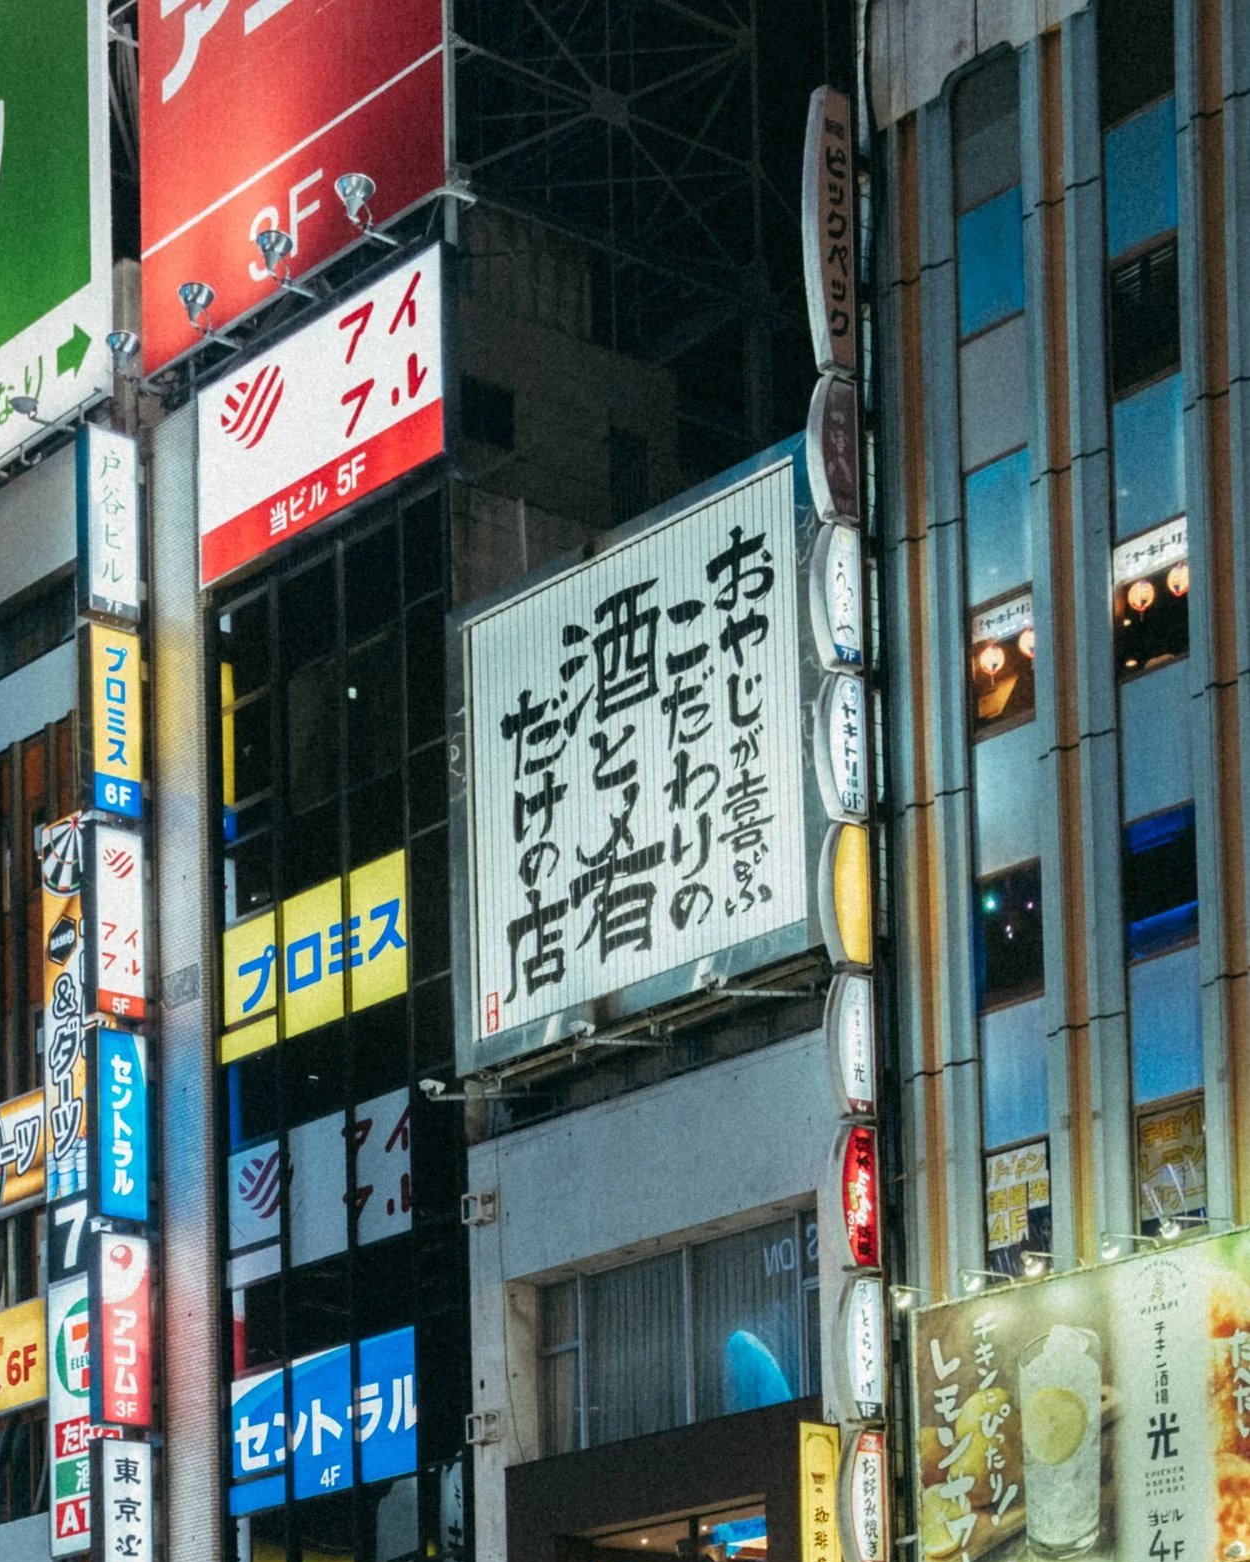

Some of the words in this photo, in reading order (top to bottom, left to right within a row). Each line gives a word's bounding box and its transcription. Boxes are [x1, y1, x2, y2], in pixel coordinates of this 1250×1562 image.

[100, 449, 128, 586] 戸谷ビル
[269, 485, 328, 537] 当ビル
[336, 451, 367, 497] 5F
[105, 646, 129, 767] プロミス
[104, 783, 132, 808] 6F
[657, 600, 723, 930] こだわりの
[841, 790, 865, 810] 6F
[499, 690, 572, 1004] だけの店
[238, 898, 407, 1014] プロミス
[111, 997, 131, 1015] 5F
[110, 1053, 135, 1197] セントラル
[989, 1208, 1029, 1246] 4F
[6, 1343, 38, 1386] 6F
[112, 1308, 139, 1394] アコム
[115, 1401, 139, 1418] 3F
[234, 1373, 419, 1472] セントラル
[855, 1403, 871, 1418] 1F
[1146, 1412, 1181, 1462] 光
[319, 1464, 341, 1488] 4F
[862, 1457, 879, 1559] お好み焼き
[1146, 1508, 1185, 1529] 当ビル
